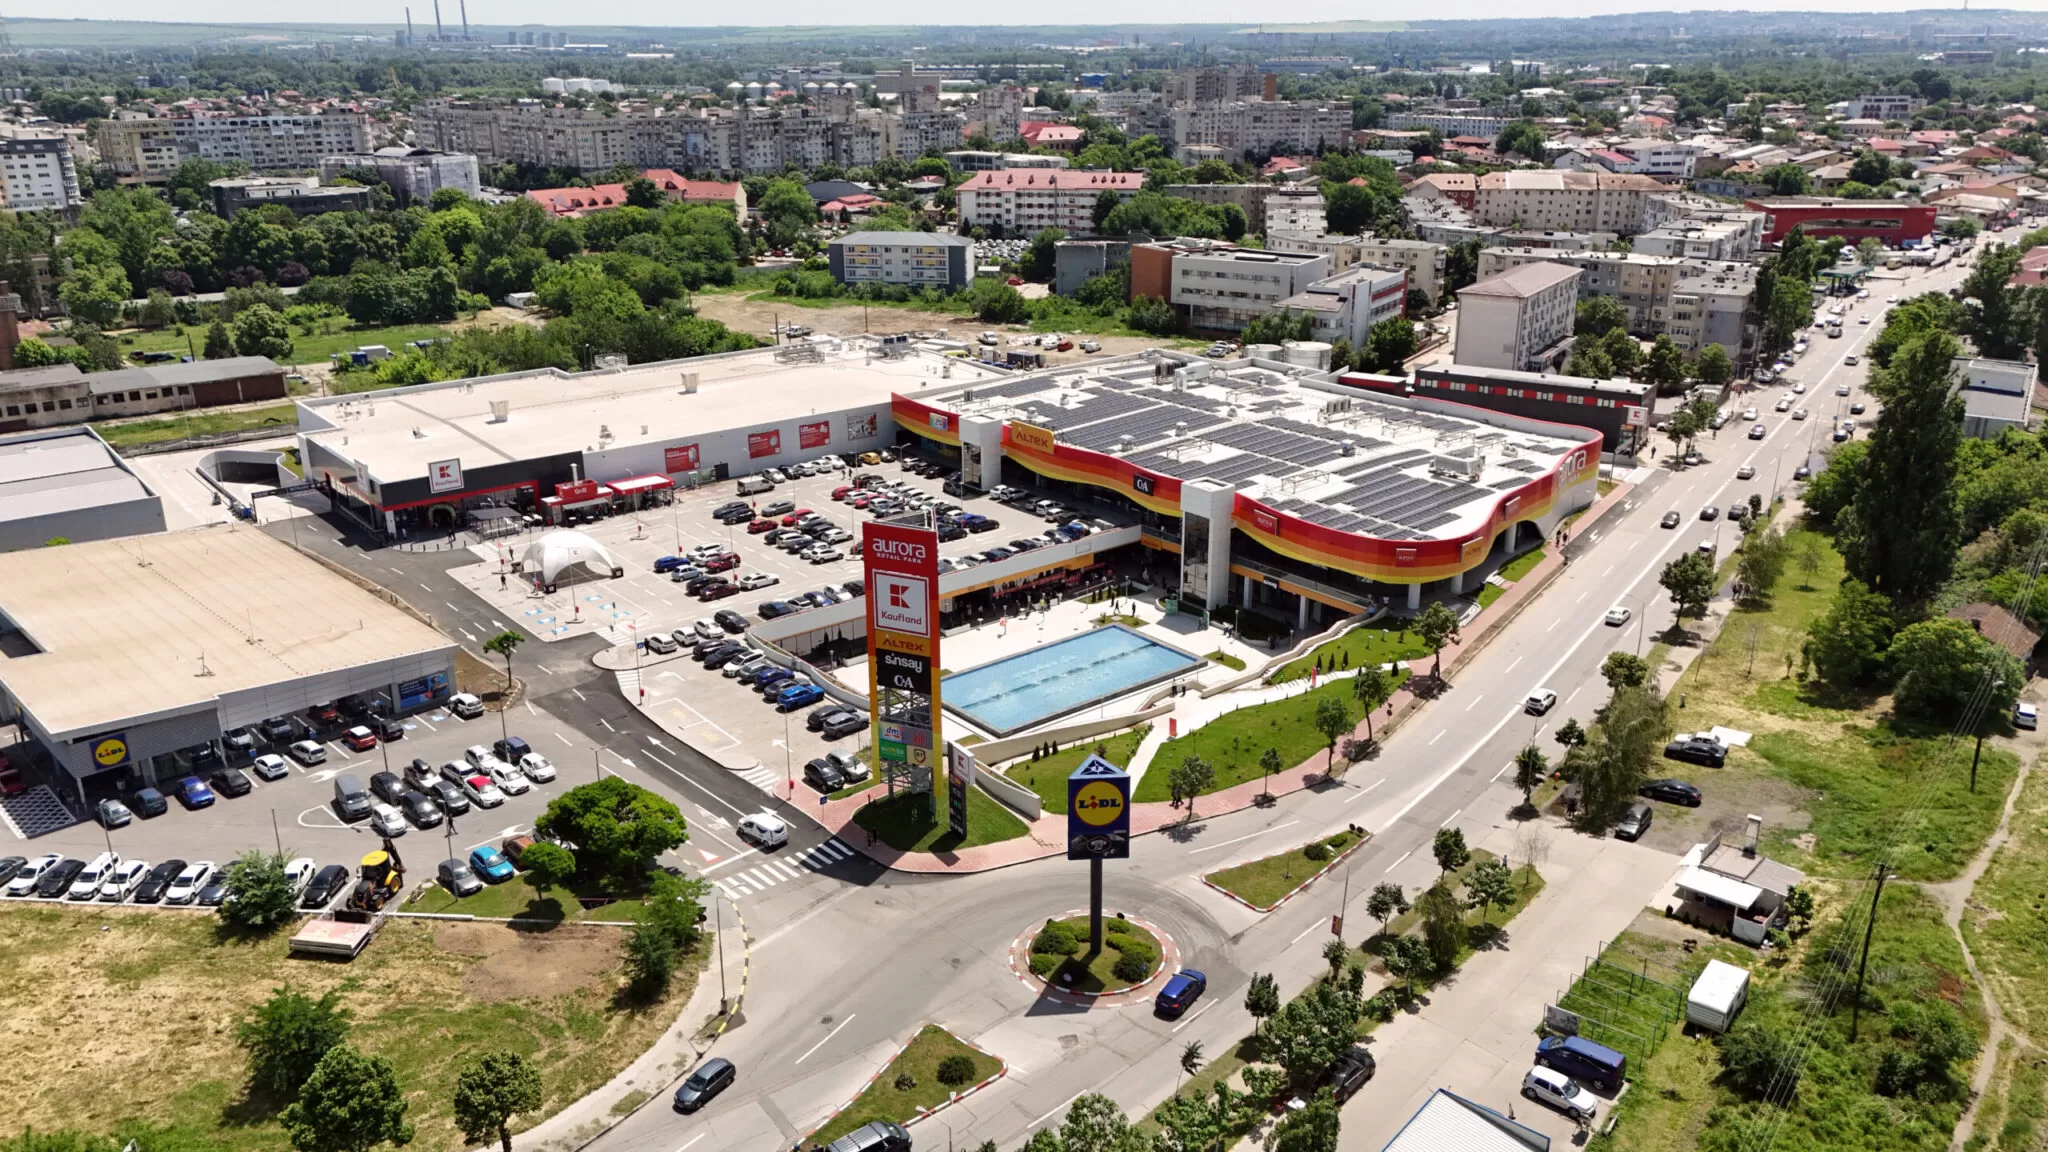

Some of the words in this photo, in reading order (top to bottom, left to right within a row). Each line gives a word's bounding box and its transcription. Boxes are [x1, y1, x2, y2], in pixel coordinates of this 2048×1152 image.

[872, 538, 926, 558] aurora
[876, 552, 901, 561] RETAIL
[903, 556, 923, 564] PARK
[890, 584, 911, 609] K
[881, 610, 922, 625] Kaufland
[885, 653, 922, 673] sinsay
[886, 726, 899, 735] dm
